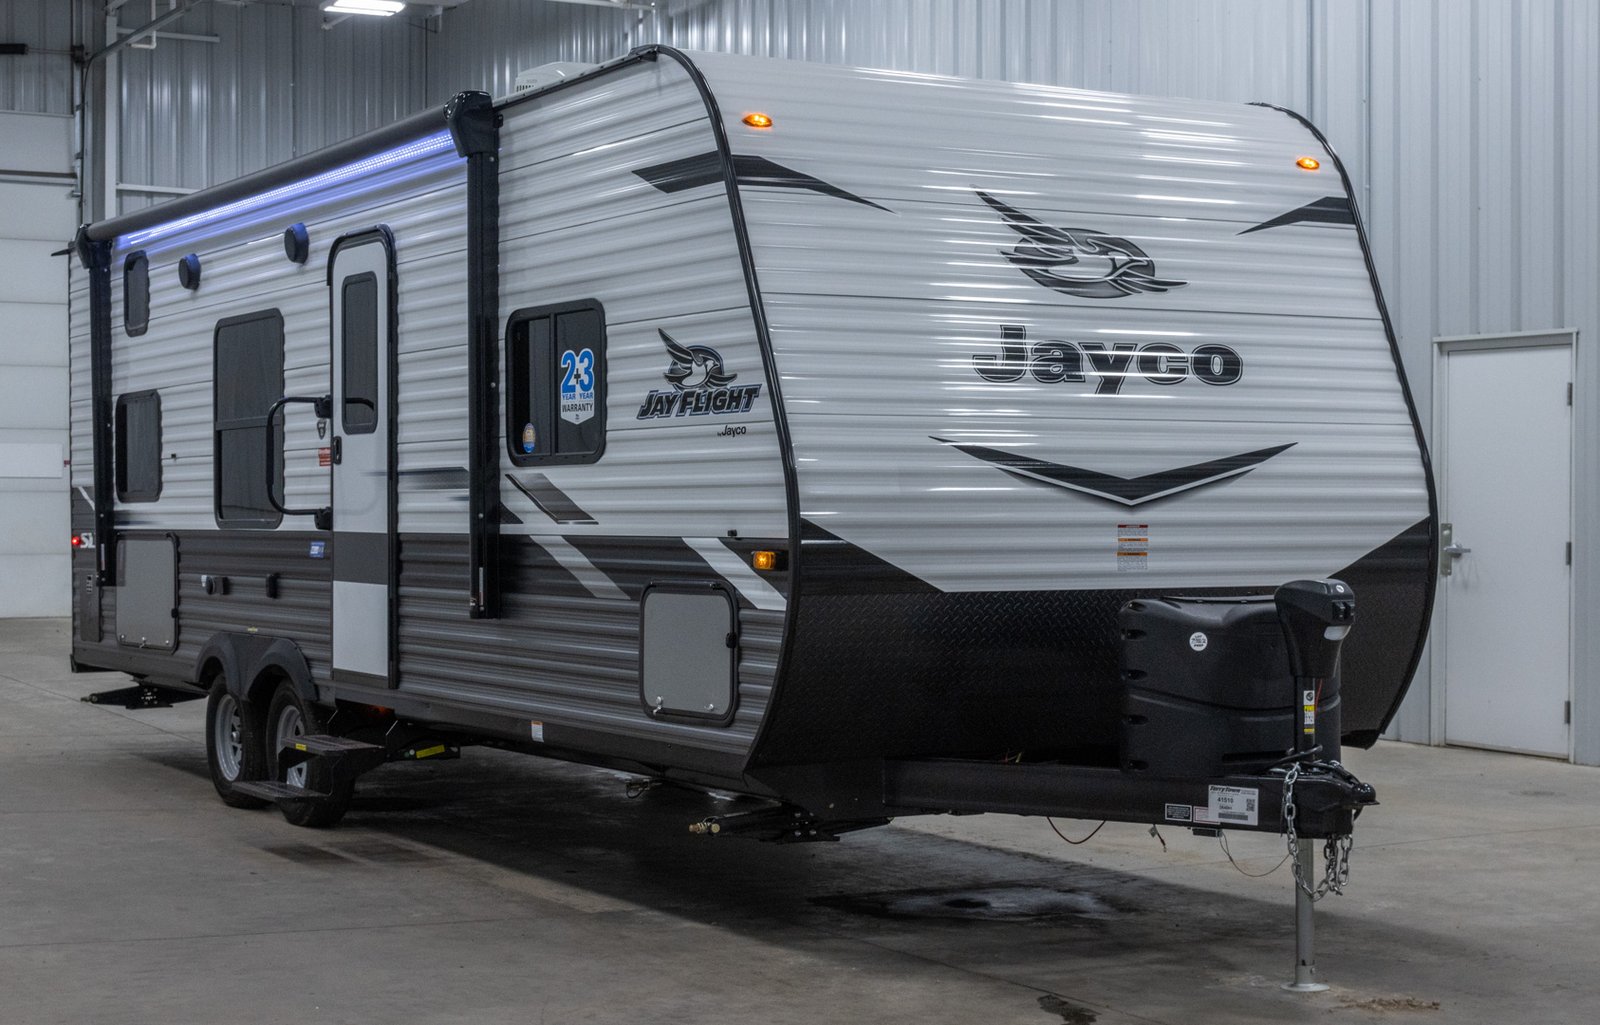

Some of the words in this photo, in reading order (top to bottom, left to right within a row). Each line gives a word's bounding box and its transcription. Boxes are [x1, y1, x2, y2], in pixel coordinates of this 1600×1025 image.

[972, 324, 1243, 395] Jayco
[562, 393, 576, 401] YEAR
[579, 392, 593, 400] YEAR
[637, 389, 680, 420] JAY
[676, 384, 762, 417] FLIGHT
[562, 403, 593, 413] WARRANTY
[721, 425, 747, 437] Jayco
